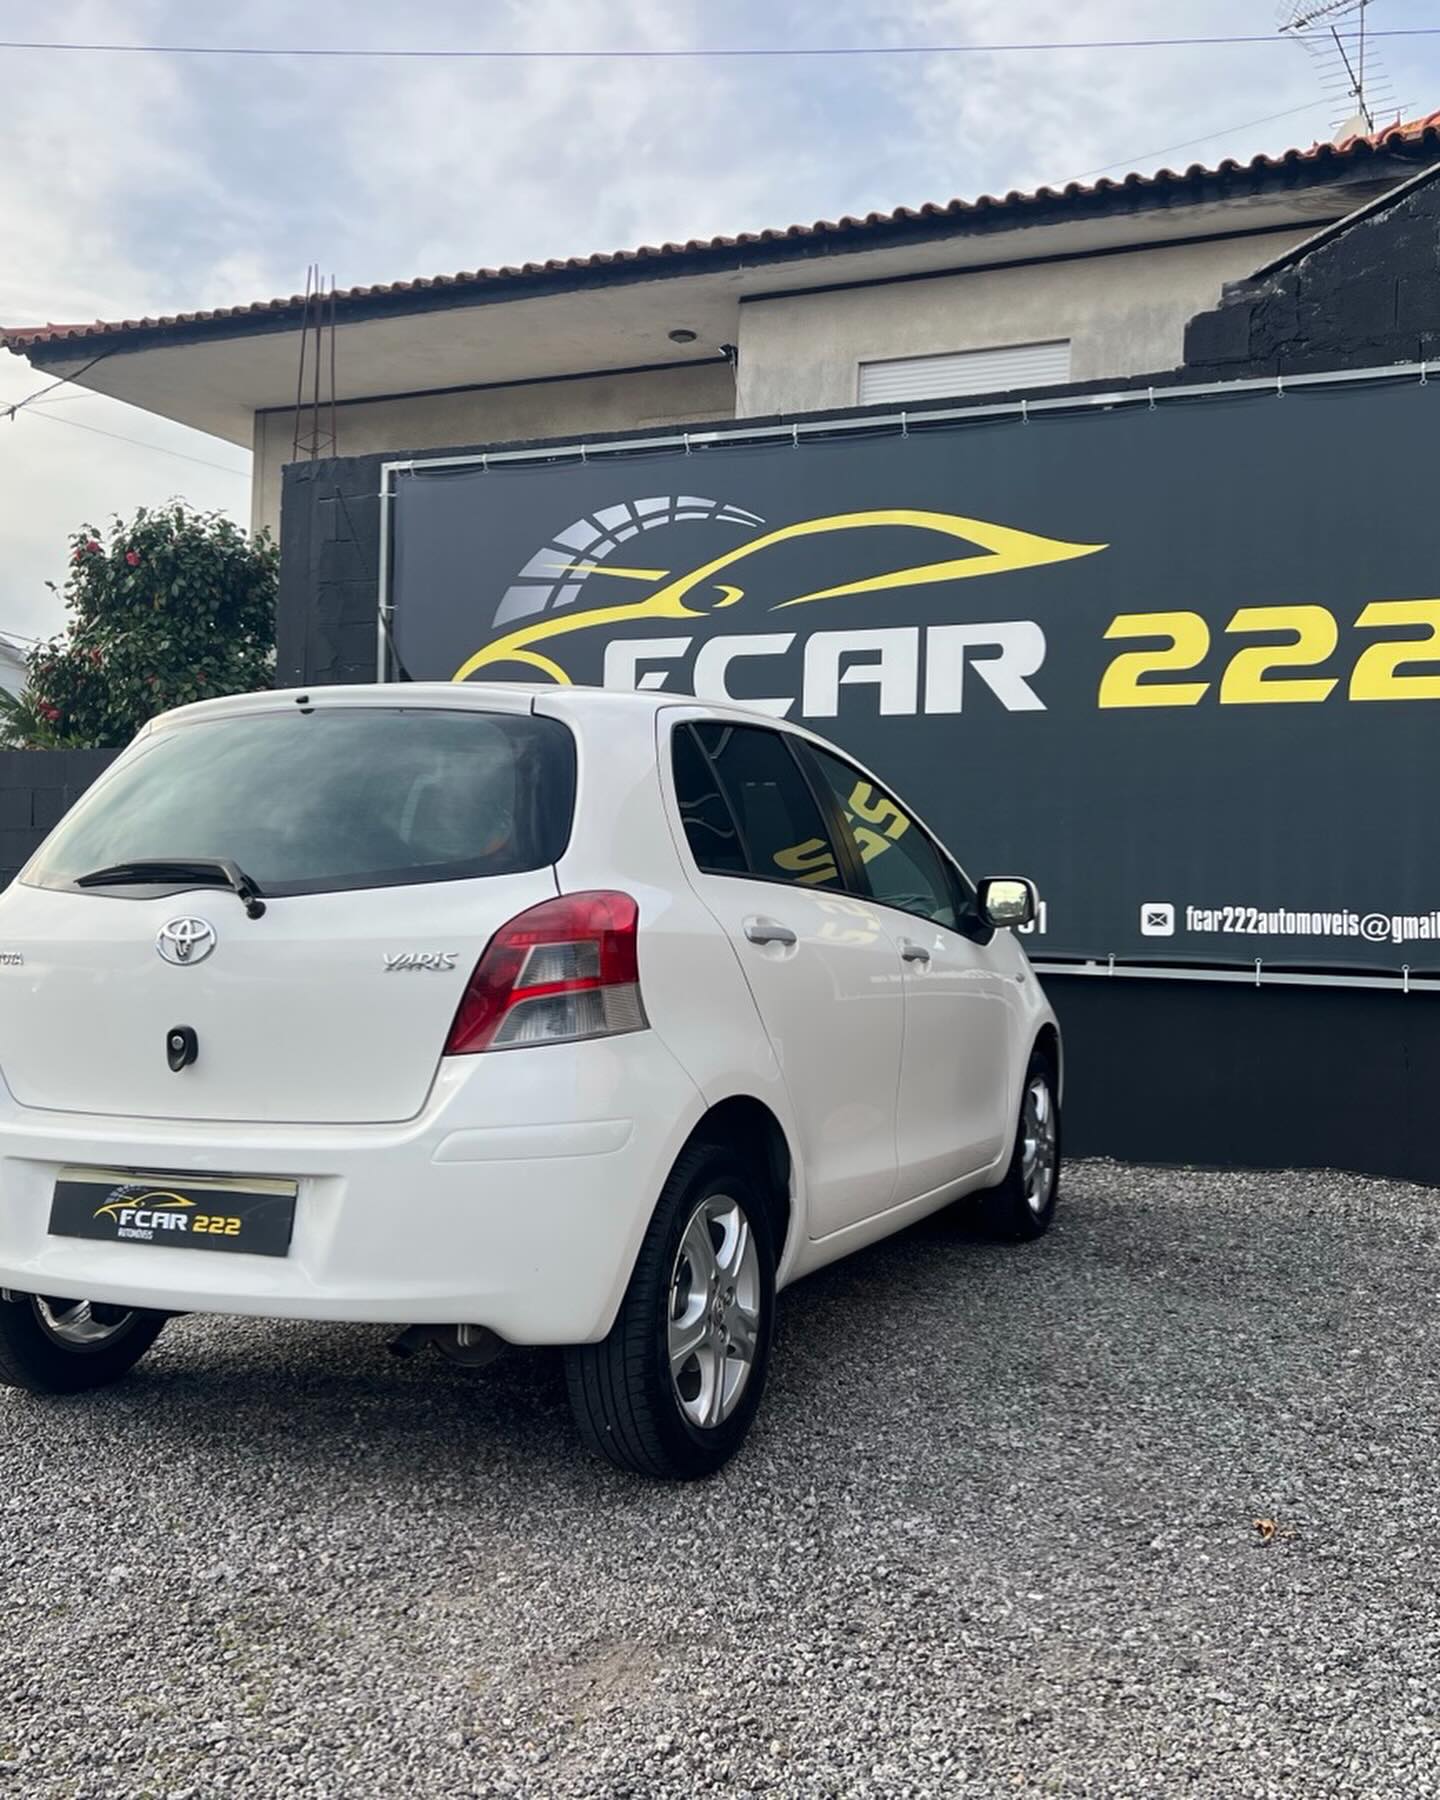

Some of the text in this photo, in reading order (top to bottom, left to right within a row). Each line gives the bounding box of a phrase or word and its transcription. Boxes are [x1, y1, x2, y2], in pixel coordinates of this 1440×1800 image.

[603, 598, 1440, 718] FCAR 222
[0, 952, 24, 966] OTA
[119, 1209, 241, 1235] FCAR 222
